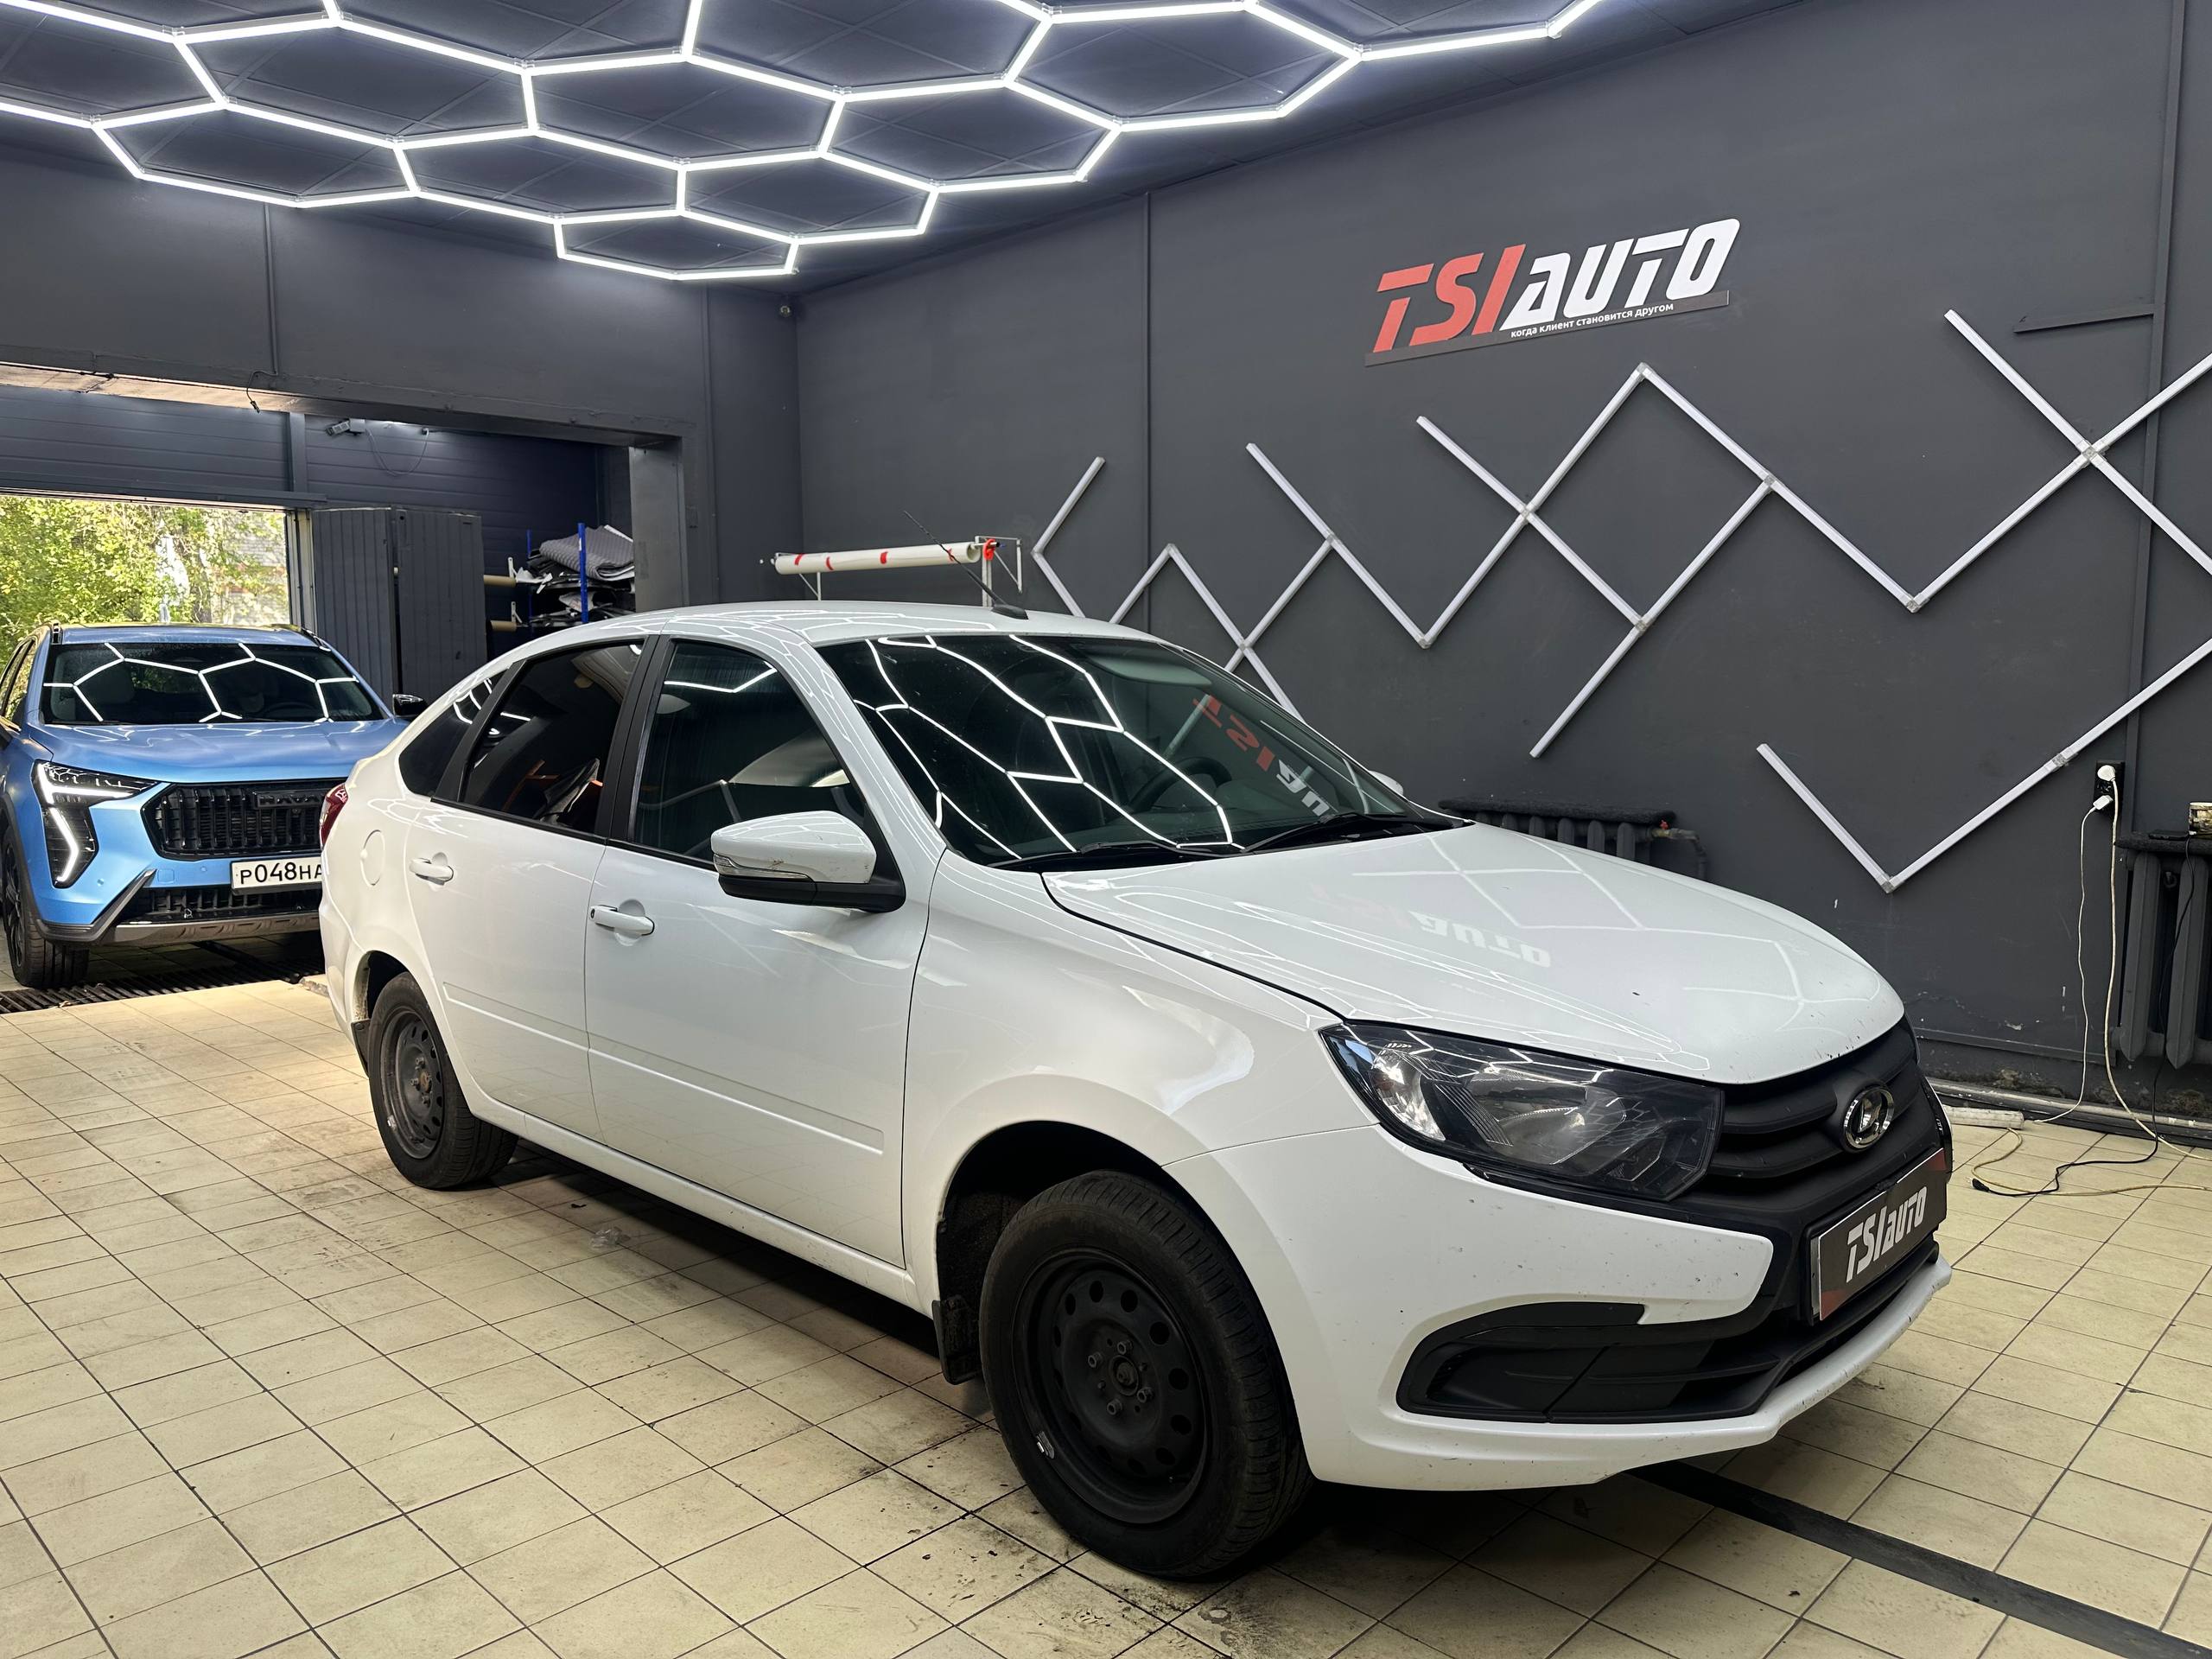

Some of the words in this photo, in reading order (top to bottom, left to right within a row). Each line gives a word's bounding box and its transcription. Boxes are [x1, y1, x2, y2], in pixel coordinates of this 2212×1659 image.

[1510, 327, 1538, 338] когда
[1540, 321, 1574, 333] клиент
[1576, 311, 1633, 326] становится
[1635, 303, 1674, 317] другом
